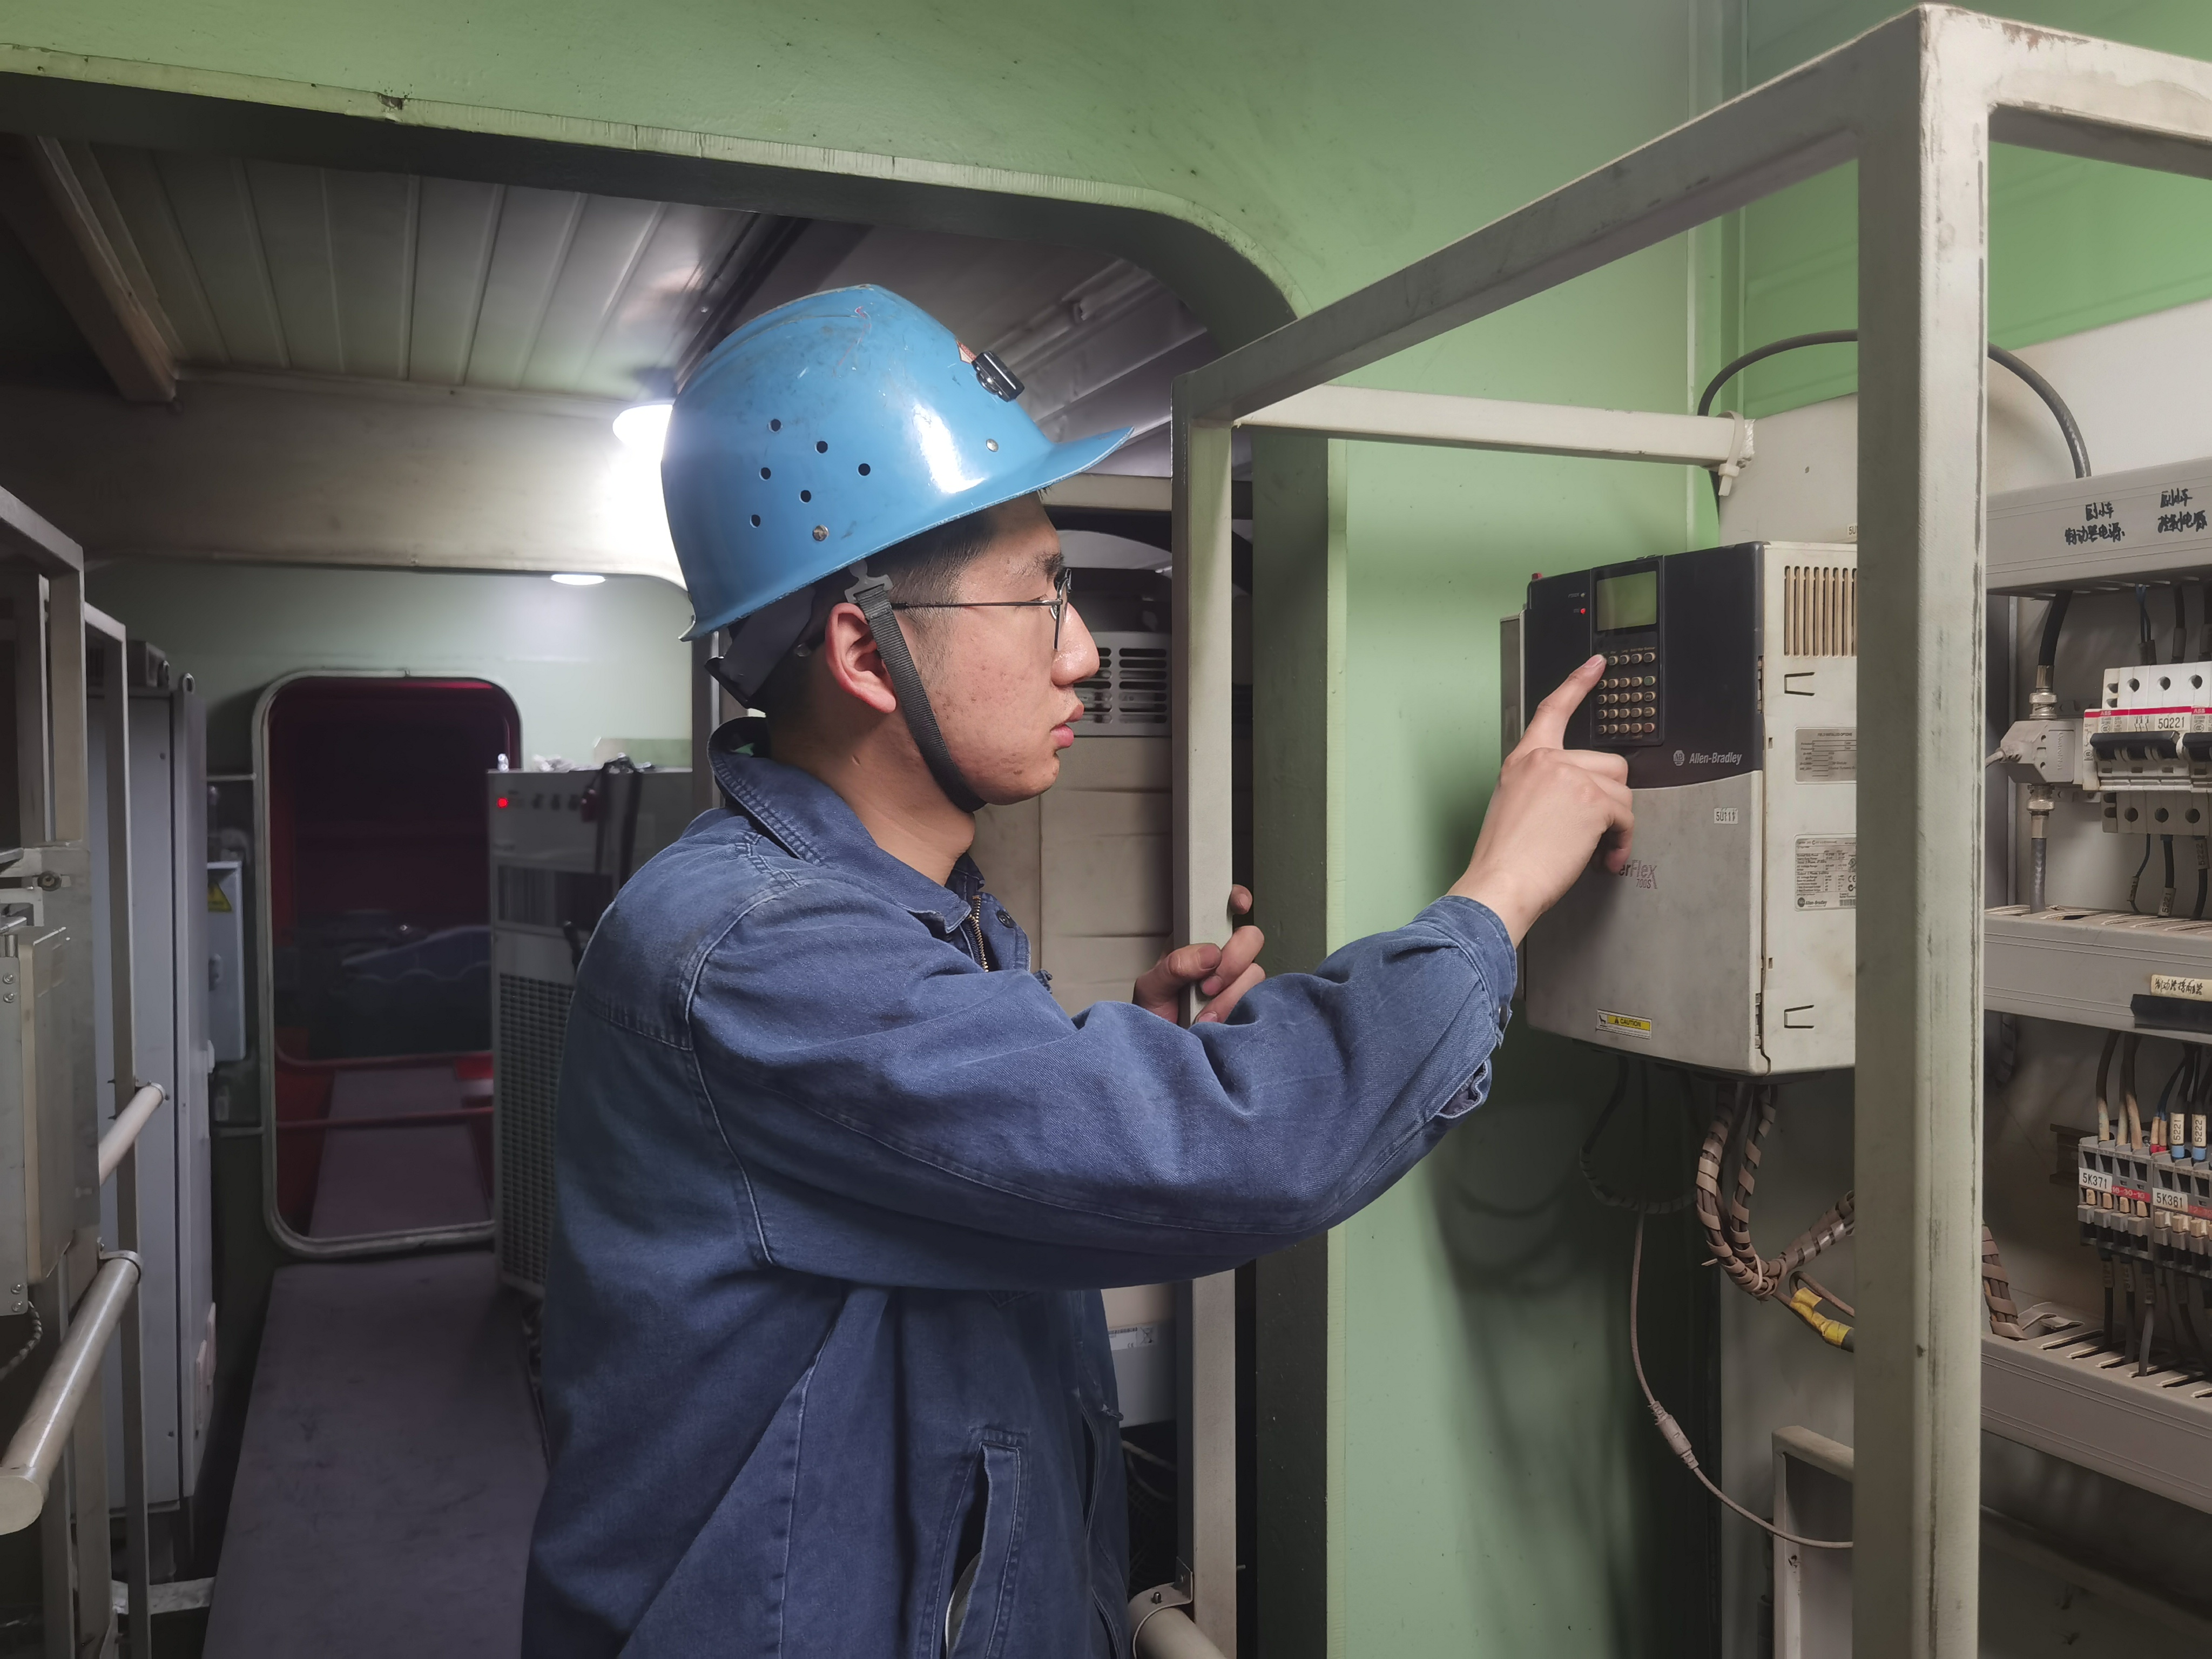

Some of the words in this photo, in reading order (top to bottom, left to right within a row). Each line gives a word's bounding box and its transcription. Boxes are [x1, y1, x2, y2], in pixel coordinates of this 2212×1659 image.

[1849, 525, 1858, 535] 5U
[2158, 716, 2185, 729] 5Q221
[1689, 752, 1742, 765] Allen-Bradley
[1636, 878, 1651, 888] 700S
[1620, 1019, 1641, 1027] CAUTION
[2173, 1120, 2182, 1141] 5221
[2082, 1172, 2107, 1189] 5K371
